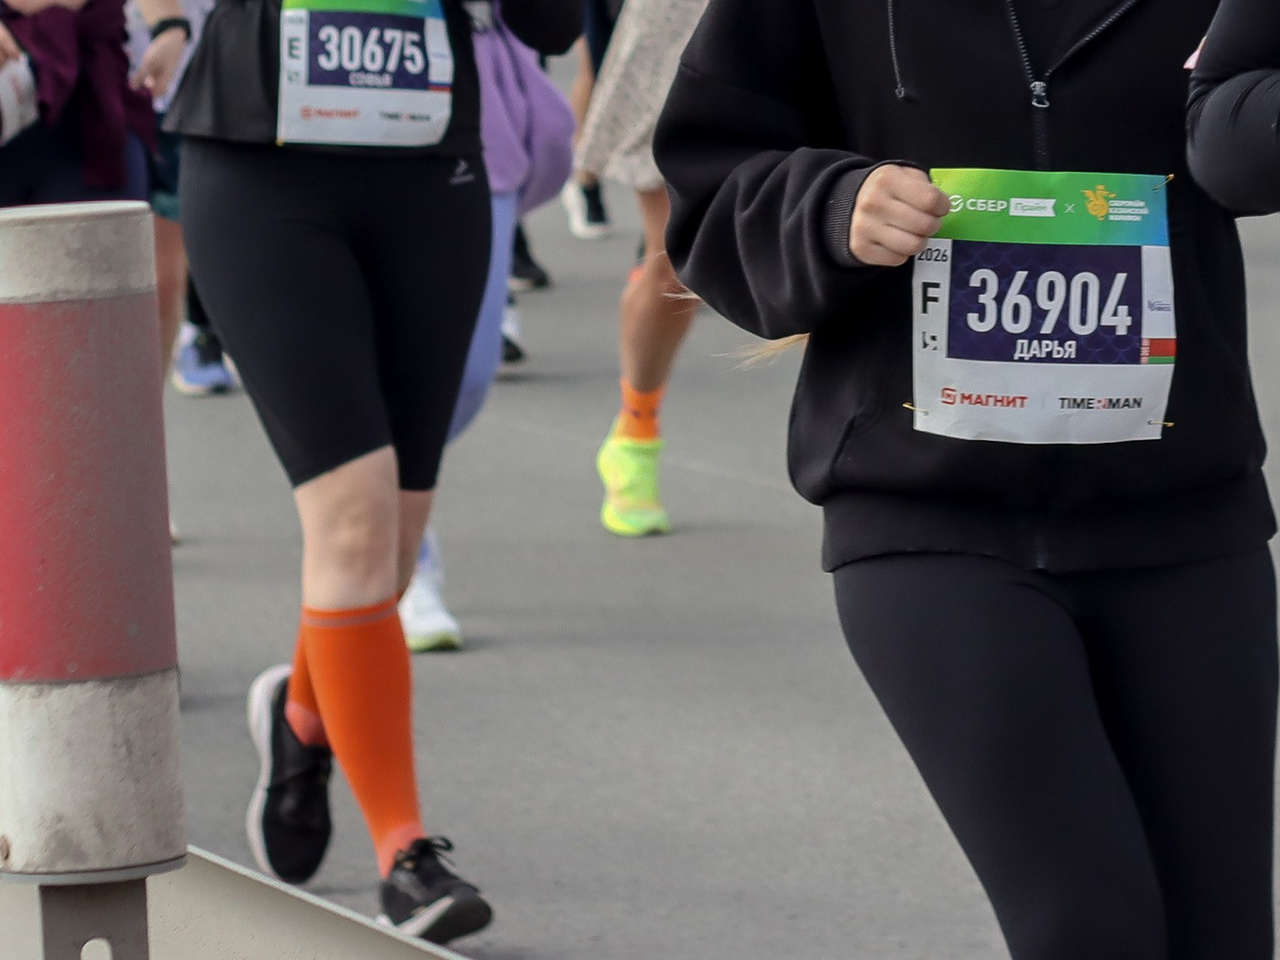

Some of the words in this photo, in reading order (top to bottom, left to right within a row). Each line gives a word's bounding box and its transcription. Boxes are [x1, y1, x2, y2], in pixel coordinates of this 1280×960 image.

[317, 25, 425, 75] 30675
[966, 198, 1007, 212] СБЕР
[917, 247, 948, 262] 2026
[921, 281, 941, 314] F
[966, 268, 1132, 336] 36904
[1013, 339, 1077, 360] ДАРЬЯ
[960, 393, 1028, 408] МАГНИТ
